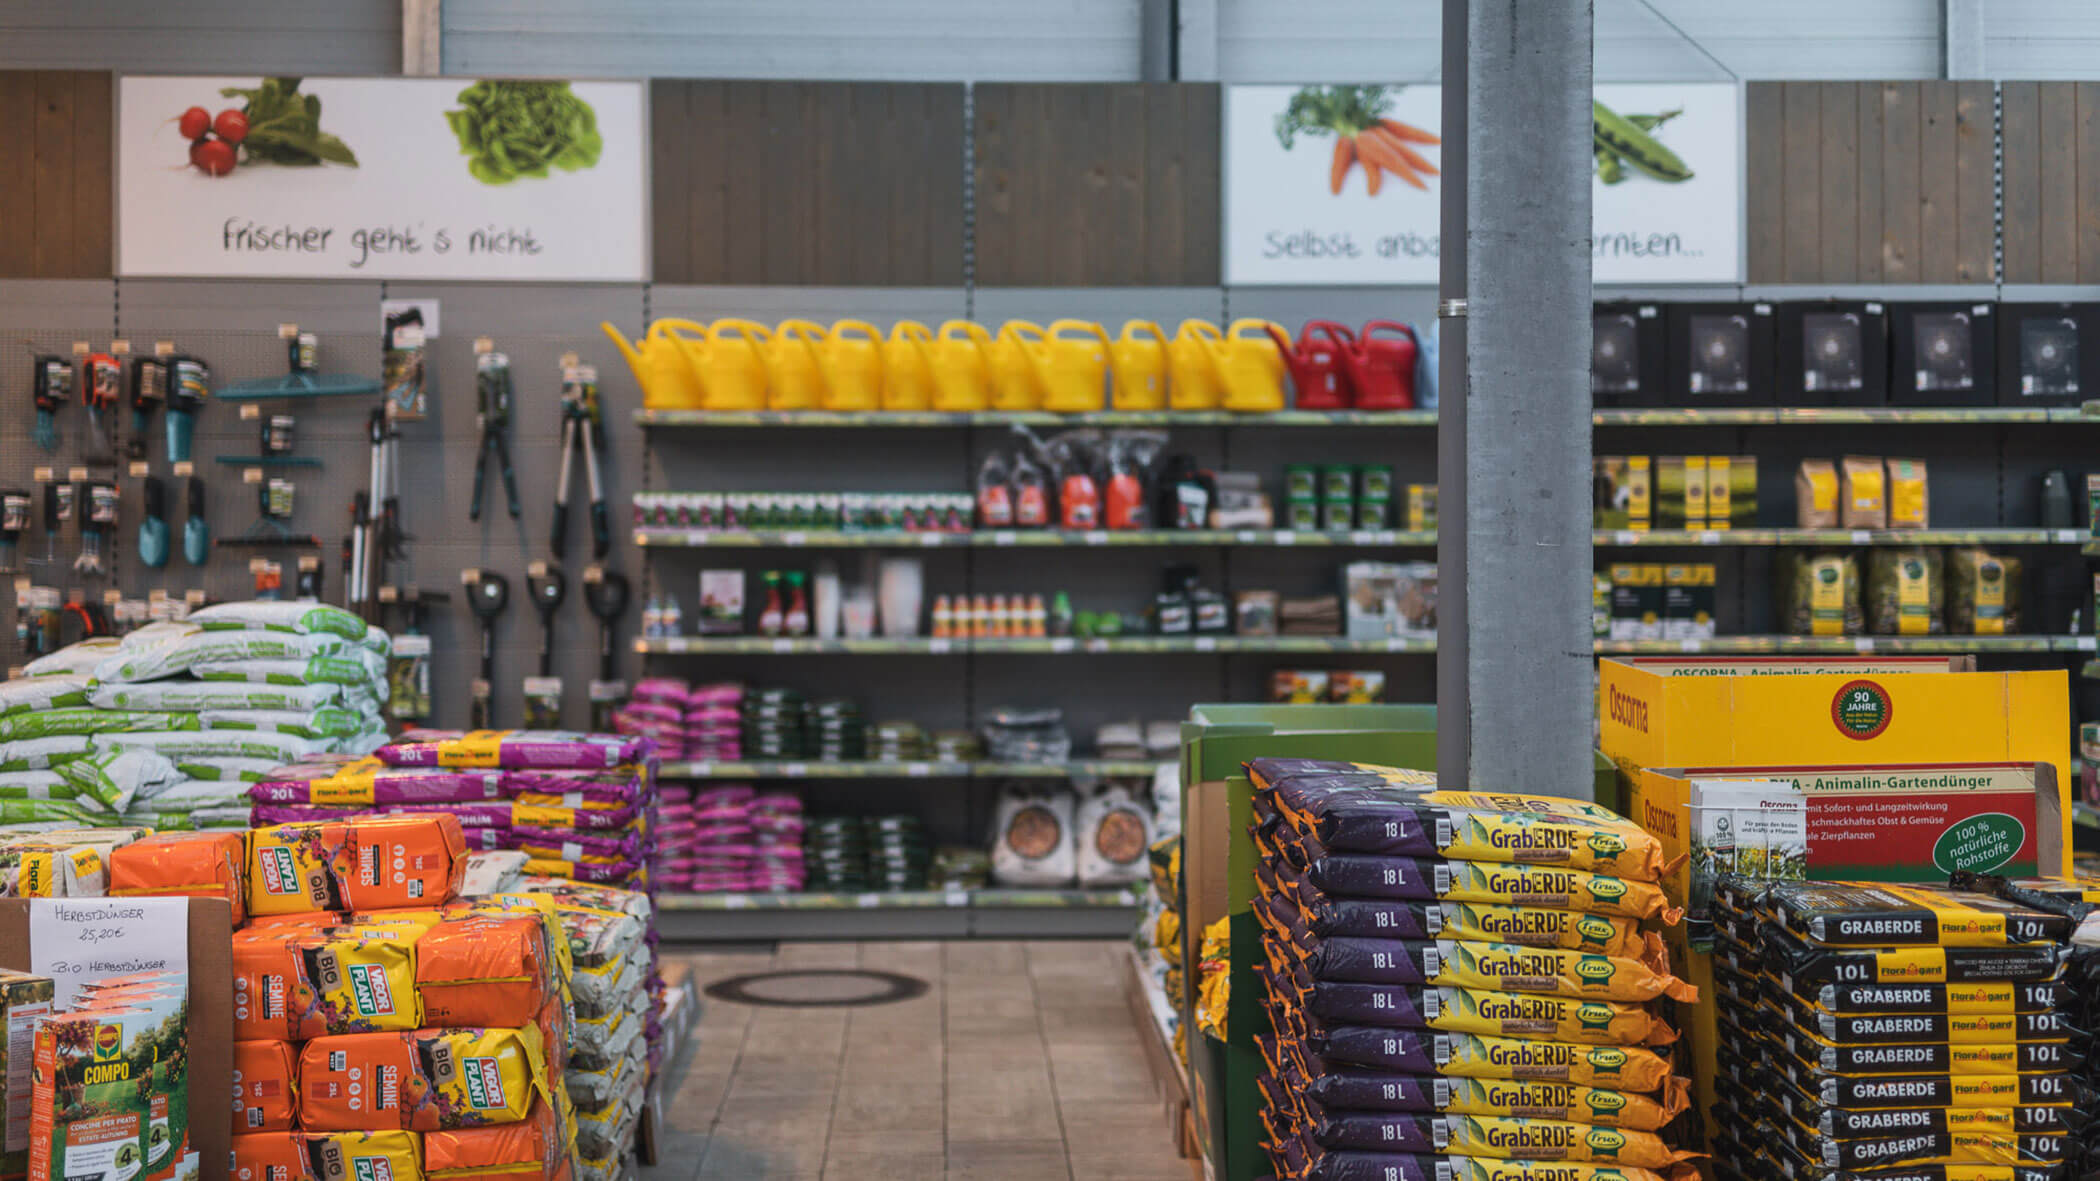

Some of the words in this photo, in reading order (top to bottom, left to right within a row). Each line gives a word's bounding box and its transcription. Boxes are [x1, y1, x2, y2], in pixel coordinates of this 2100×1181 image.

[468, 224, 544, 256] nicht
[1261, 229, 1363, 259] Selbst
[1846, 702, 1877, 711] JAHRE
[1854, 691, 1870, 702] 90
[1609, 683, 1649, 733] Oscorna
[1815, 774, 1992, 791] Animalin-Gartendünger
[1823, 802, 1854, 813] Sofort-
[1856, 802, 1873, 812] und
[1875, 801, 1948, 814] Langzeitwirkung
[1644, 799, 1677, 839] Oscorna
[1811, 816, 1876, 827] schmackhaftes
[1877, 816, 1899, 826] Obst
[1900, 816, 1907, 825] &
[1909, 814, 1945, 826] Gemüse
[1385, 822, 1398, 838] 18
[1401, 823, 1408, 838] L
[1491, 828, 1579, 850] GrabERDE
[1820, 831, 1875, 842] Zierpflanzen
[1955, 826, 1976, 841] 100
[1978, 821, 1990, 833] %
[1949, 830, 2008, 859] natürliche
[360, 846, 375, 886] SEMINE
[1956, 842, 2009, 870] Rohstoffe
[262, 849, 281, 893] VIGOR
[276, 848, 298, 891] PLANT
[1383, 869, 1396, 884] 18
[1399, 870, 1406, 885] L
[312, 875, 327, 901] BIO
[1489, 873, 1578, 894] GrabERDE
[1375, 912, 1388, 927] 18
[1391, 913, 1398, 927] L
[1481, 912, 1569, 933] GrabERDE
[1839, 919, 1923, 936] GRABERDE
[2016, 920, 2046, 938] 10L
[321, 955, 338, 985] BIO
[1372, 953, 1385, 968] 18
[1389, 953, 1396, 968] L
[1478, 955, 1567, 977] GrabERDE
[1834, 964, 1869, 981] 10L
[269, 975, 285, 1020] SEMINE
[352, 967, 374, 1013] PLANT
[370, 966, 391, 1011] VIGOR
[1850, 989, 1932, 1004] GRABERDE
[1372, 993, 1385, 1009] 18
[1389, 993, 1396, 1009] L
[1479, 999, 1567, 1021] GrabERDE
[1851, 1018, 1933, 1034] GRABERDE
[2027, 1015, 2060, 1031] 10L
[1383, 1039, 1396, 1055] 18
[1399, 1039, 1406, 1055] L
[1490, 1045, 1578, 1066] GrabERDE
[1852, 1048, 1934, 1064] GRABERDE
[2028, 1046, 2060, 1062] 10L
[434, 1046, 451, 1077] BIO
[84, 1061, 130, 1085] COMPO
[482, 1061, 502, 1105] VIGOR
[383, 1065, 398, 1109] SEMINE
[464, 1061, 487, 1108] PLANT
[1382, 1084, 1396, 1099] 18
[1399, 1084, 1406, 1099] L
[1853, 1082, 1936, 1098] GRABERDE
[2030, 1078, 2062, 1094] 10L
[1489, 1086, 1577, 1107] GrabERDE
[1848, 1112, 1931, 1129] GRABERDE
[2025, 1108, 2057, 1123] 10L
[1382, 1125, 1395, 1141] 18
[1398, 1125, 1405, 1141] L
[1488, 1126, 1576, 1148] GrabERDE
[1854, 1134, 1936, 1159] GRABERDE
[2030, 1138, 2060, 1153] 10L
[120, 1147, 132, 1166] 4
[325, 1147, 343, 1177] BIO
